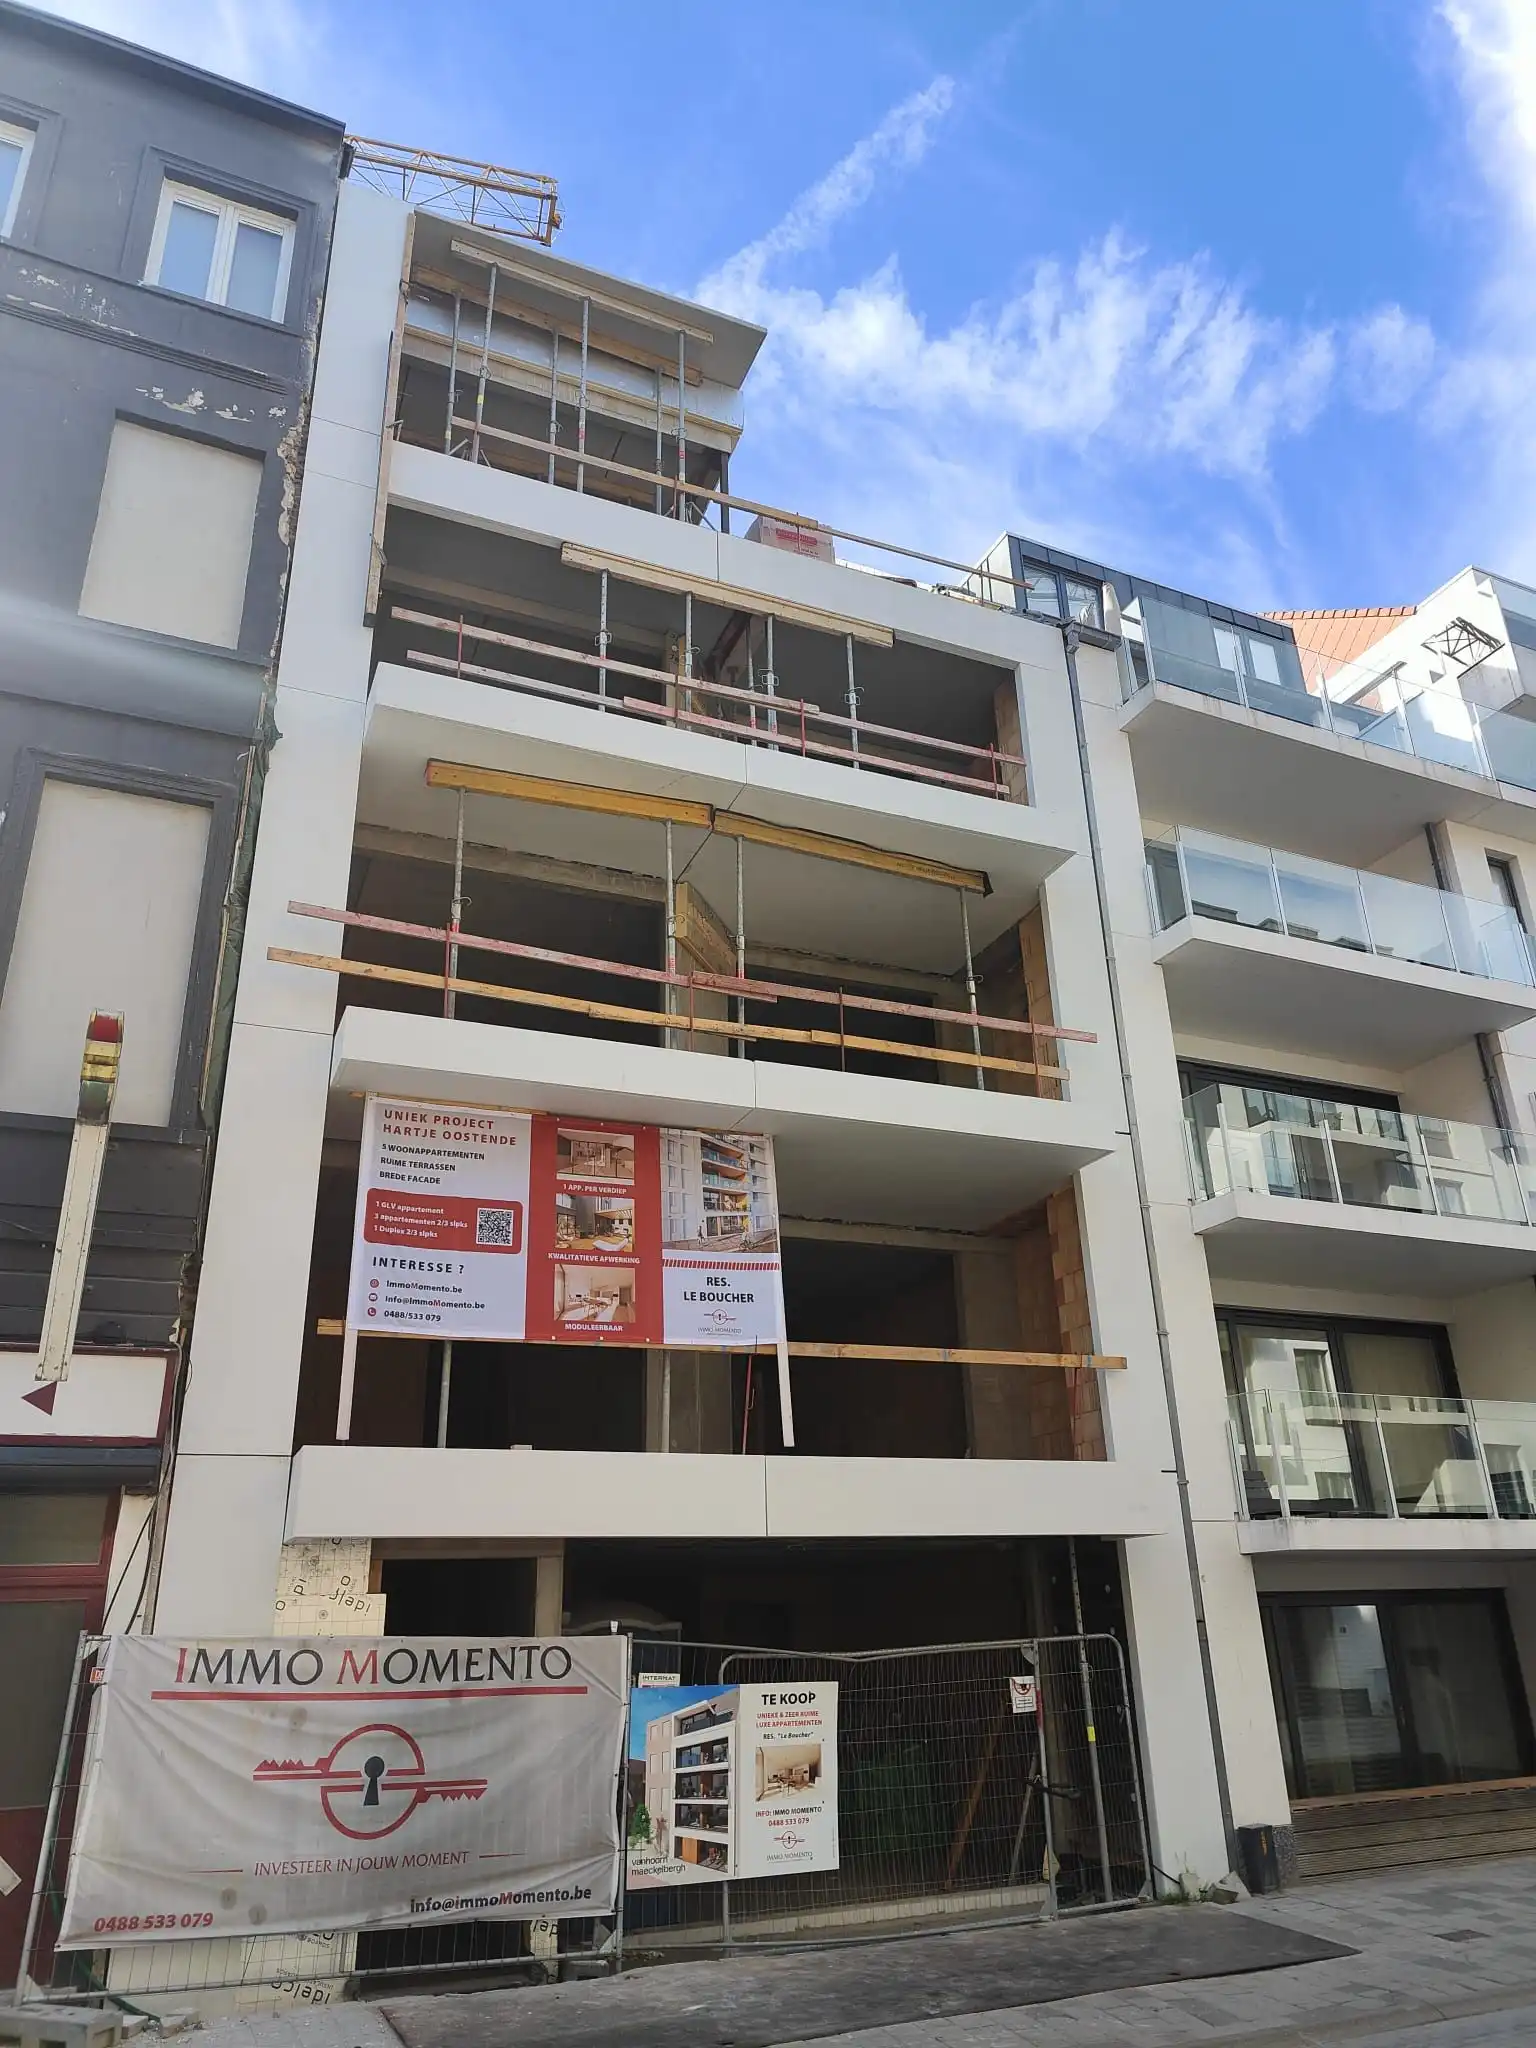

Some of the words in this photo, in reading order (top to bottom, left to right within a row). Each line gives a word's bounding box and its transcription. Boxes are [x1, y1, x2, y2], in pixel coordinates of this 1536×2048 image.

[384, 1109, 428, 1124] UNIEK
[433, 1115, 494, 1130] PROJECT
[383, 1123, 437, 1139] HARTJE
[442, 1130, 517, 1146] OOSTENDE
[388, 1144, 485, 1160] WOONAPPARTEMENTEN
[380, 1156, 407, 1167] RUIME
[408, 1161, 456, 1171] TERRASSEN
[379, 1170, 406, 1182] BREDE
[407, 1175, 441, 1185] FACADE
[568, 1184, 584, 1192] APP.
[585, 1185, 598, 1193] PER
[598, 1186, 627, 1195] VERDIEP
[381, 1202, 397, 1210] GLV
[397, 1205, 444, 1215] appartement
[380, 1214, 436, 1227] appartementen
[436, 1219, 449, 1227] 2/3
[449, 1219, 468, 1228] slpks
[379, 1226, 405, 1236] Duplex
[406, 1228, 418, 1236] 2/3
[418, 1230, 438, 1238] slpks
[548, 1252, 599, 1262] KWALITATIEVE
[600, 1256, 640, 1264] AFWERKING
[372, 1256, 453, 1273] INTERESSE
[458, 1264, 465, 1274] ?
[706, 1276, 731, 1287] RES.
[683, 1291, 697, 1301] LE
[699, 1292, 754, 1303] BOUCHER
[384, 1310, 424, 1321] 0488/533
[425, 1313, 441, 1322] 079
[564, 1323, 624, 1332] MODULEERBAAR
[173, 1647, 324, 1686] IMMO
[336, 1644, 572, 1686] MOMENTO
[761, 1693, 777, 1706] TE
[780, 1692, 816, 1705] KOOP
[756, 1711, 779, 1719] UNIEKE
[772, 1719, 823, 1728] APPARTEMENTEN
[755, 1810, 772, 1818] INFO:
[773, 1808, 790, 1816] IMMO
[791, 1806, 822, 1815] MOMENTO
[785, 1818, 797, 1826] 533
[766, 1853, 784, 1861] IMMO
[785, 1851, 813, 1859] MOMENTO
[254, 1859, 332, 1876] INVESTEER
[336, 1859, 351, 1872] IN
[354, 1855, 400, 1874] JOUW
[401, 1851, 470, 1868] MOMENT
[410, 1885, 592, 1913] info@immoMomento.be
[94, 1916, 140, 1932] 0488
[142, 1914, 177, 1929] 533
[180, 1912, 214, 1928] 079
